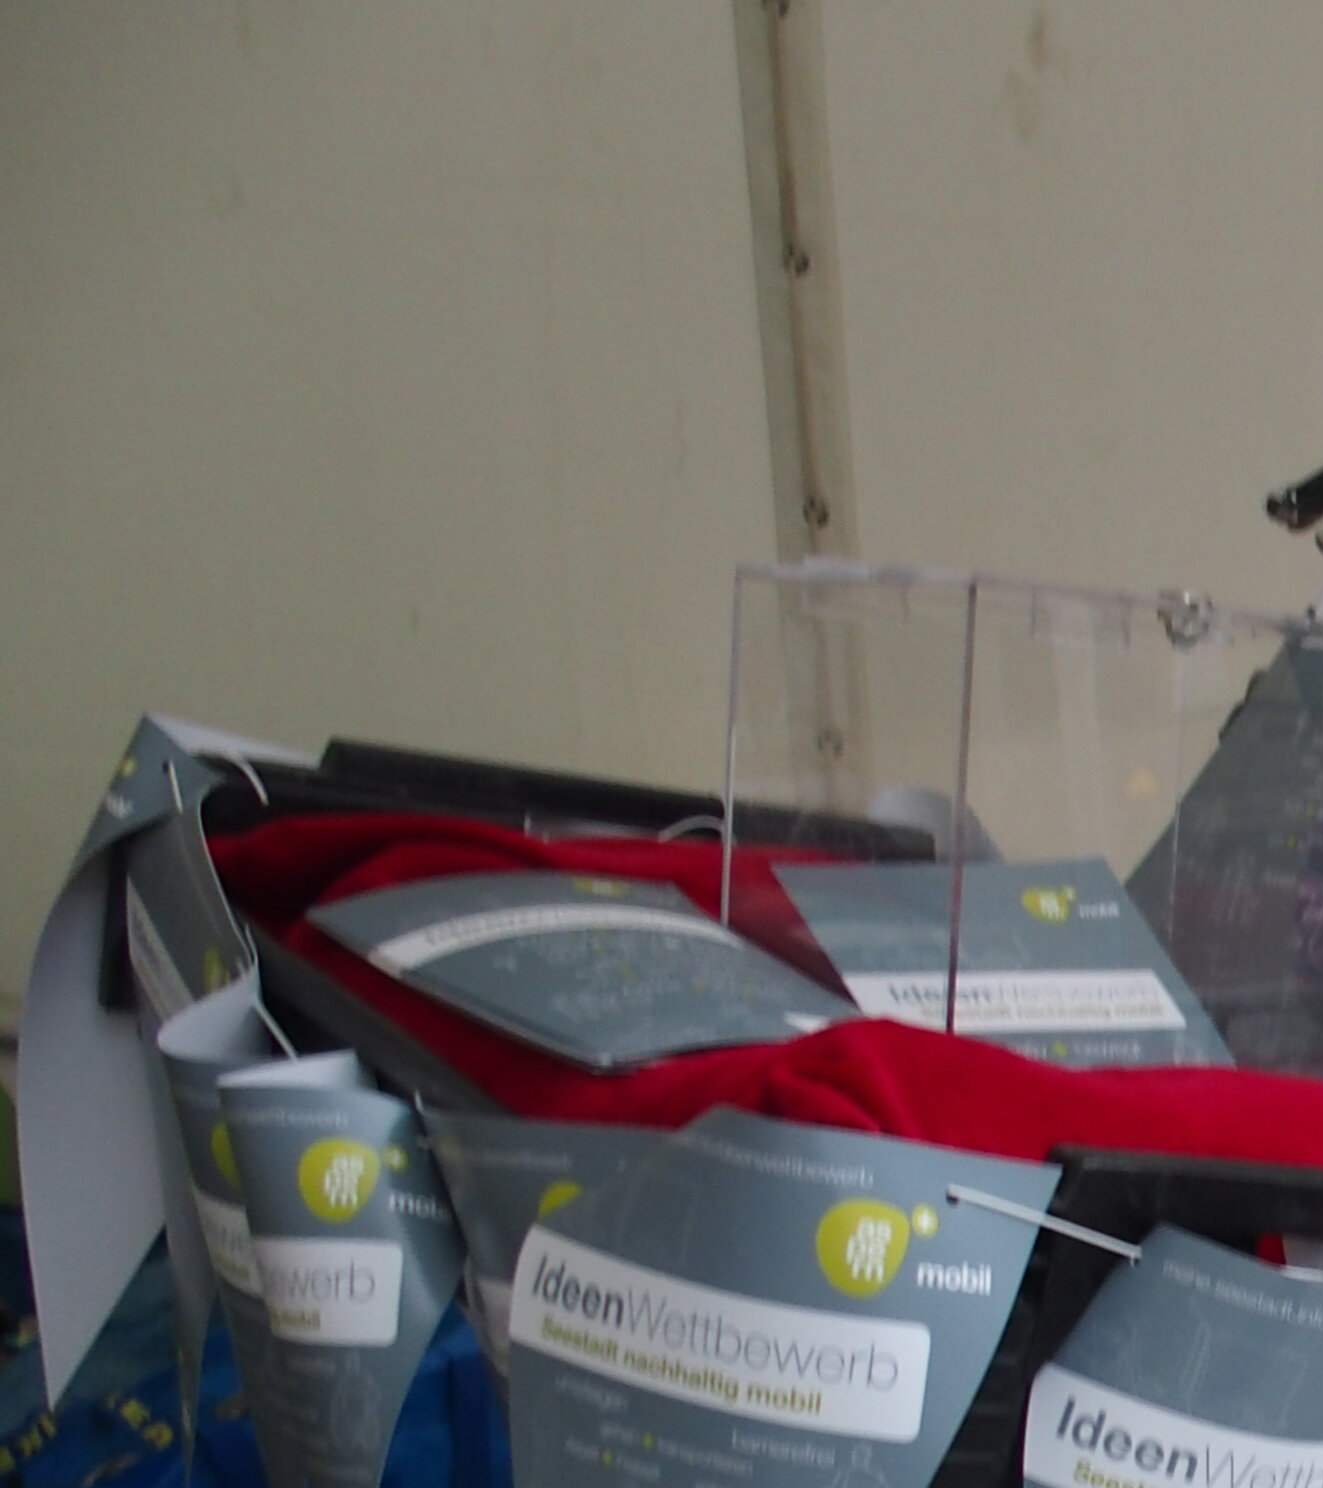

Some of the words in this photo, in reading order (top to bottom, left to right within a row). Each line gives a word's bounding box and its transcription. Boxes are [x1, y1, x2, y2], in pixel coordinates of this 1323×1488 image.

[532, 1253, 899, 1393] IdeenWettbewerb
[917, 1260, 992, 1297] mobil
[541, 1313, 619, 1366] Seestadt
[622, 1345, 739, 1403] nachhaltig
[746, 1379, 822, 1416] mobil
